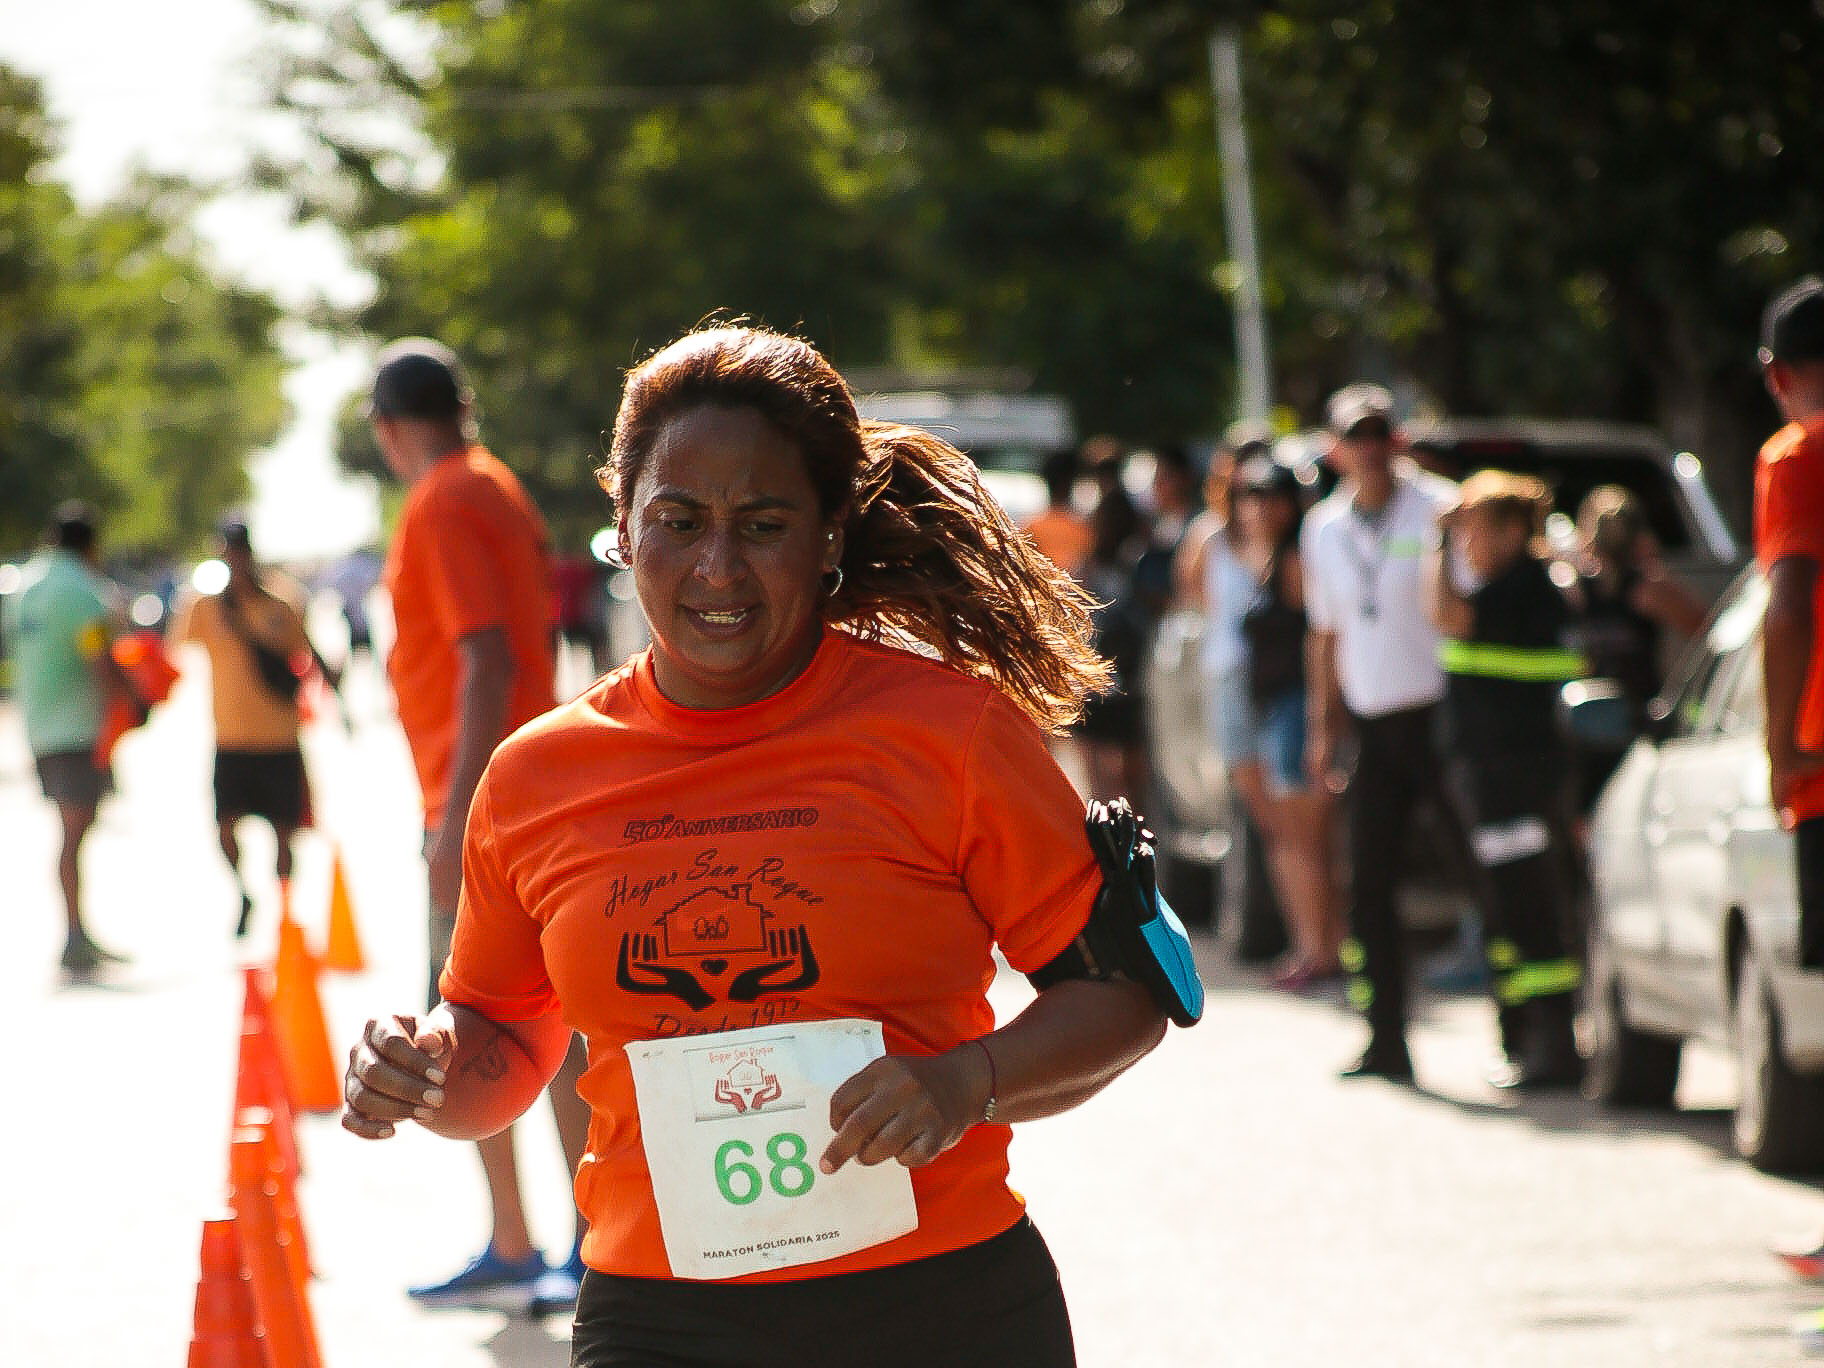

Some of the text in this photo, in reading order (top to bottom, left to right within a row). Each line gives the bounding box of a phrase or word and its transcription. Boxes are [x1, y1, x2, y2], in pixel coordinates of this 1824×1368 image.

[604, 869, 678, 918] Hogar
[686, 848, 739, 881] San
[714, 1131, 815, 1206] 68
[703, 1230, 840, 1259] MARATON SOLIDARIA 2025
